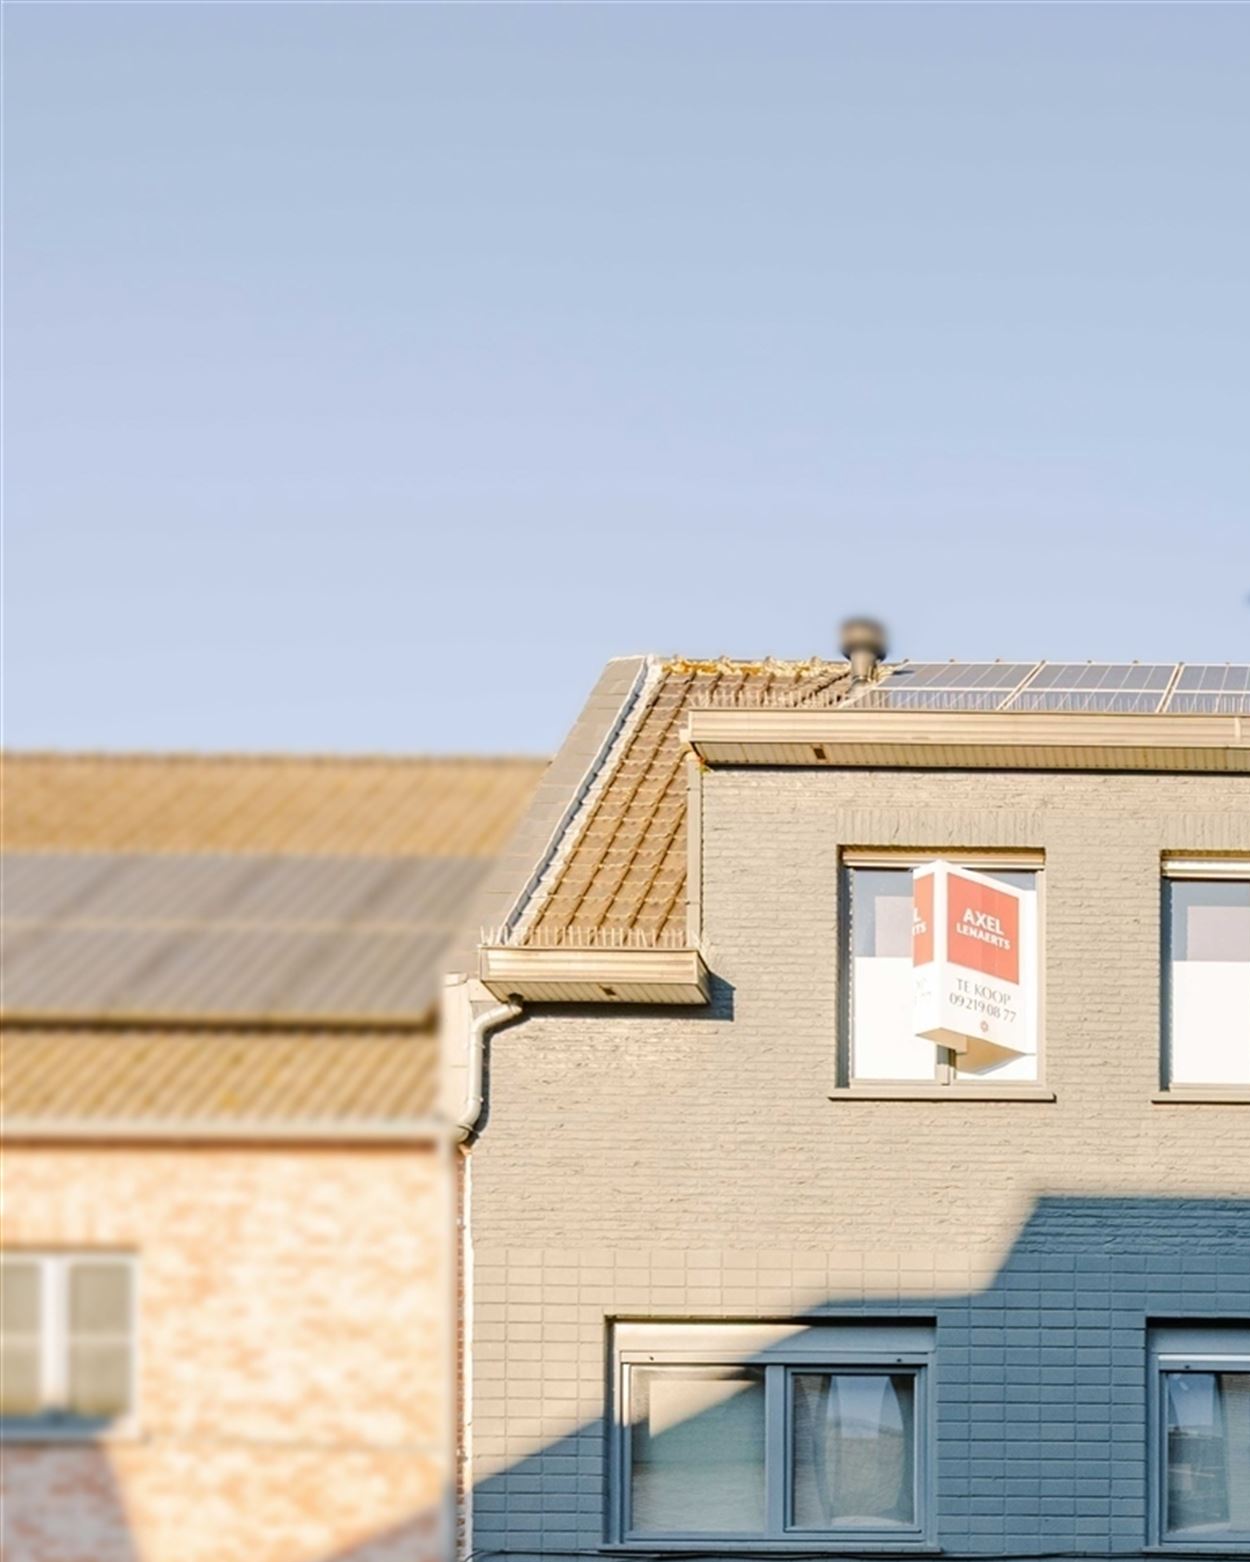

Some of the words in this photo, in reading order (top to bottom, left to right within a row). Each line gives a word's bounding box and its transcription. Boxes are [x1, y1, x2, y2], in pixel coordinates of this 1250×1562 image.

[963, 908, 1005, 935] AXEL
[956, 922, 1011, 950] LENAERTS
[956, 978, 969, 993] TE
[974, 984, 1011, 1005] KOOP
